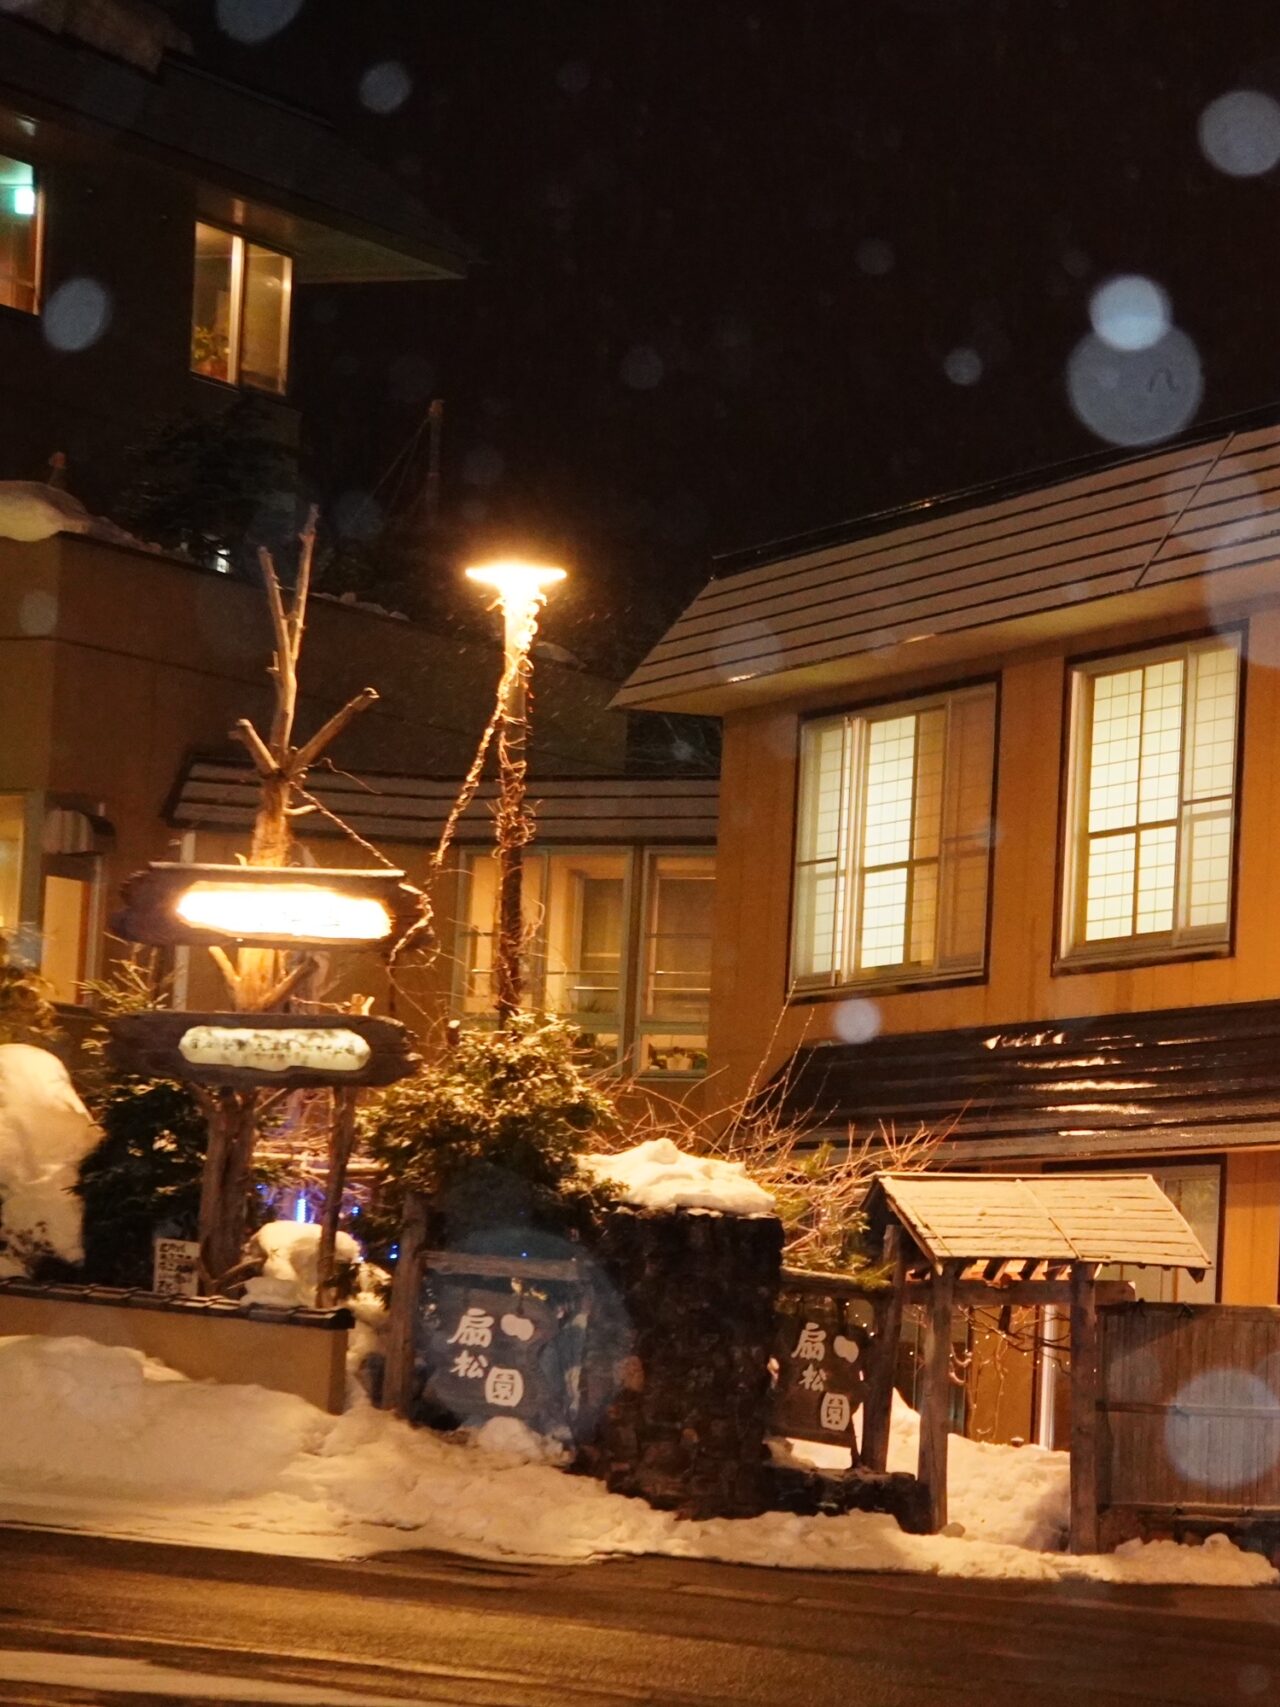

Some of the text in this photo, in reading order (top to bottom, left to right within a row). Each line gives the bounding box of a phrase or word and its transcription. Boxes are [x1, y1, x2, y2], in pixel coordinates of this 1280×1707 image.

[447, 1308, 524, 1407] 扇松園
[791, 1322, 850, 1431] 扇松園
